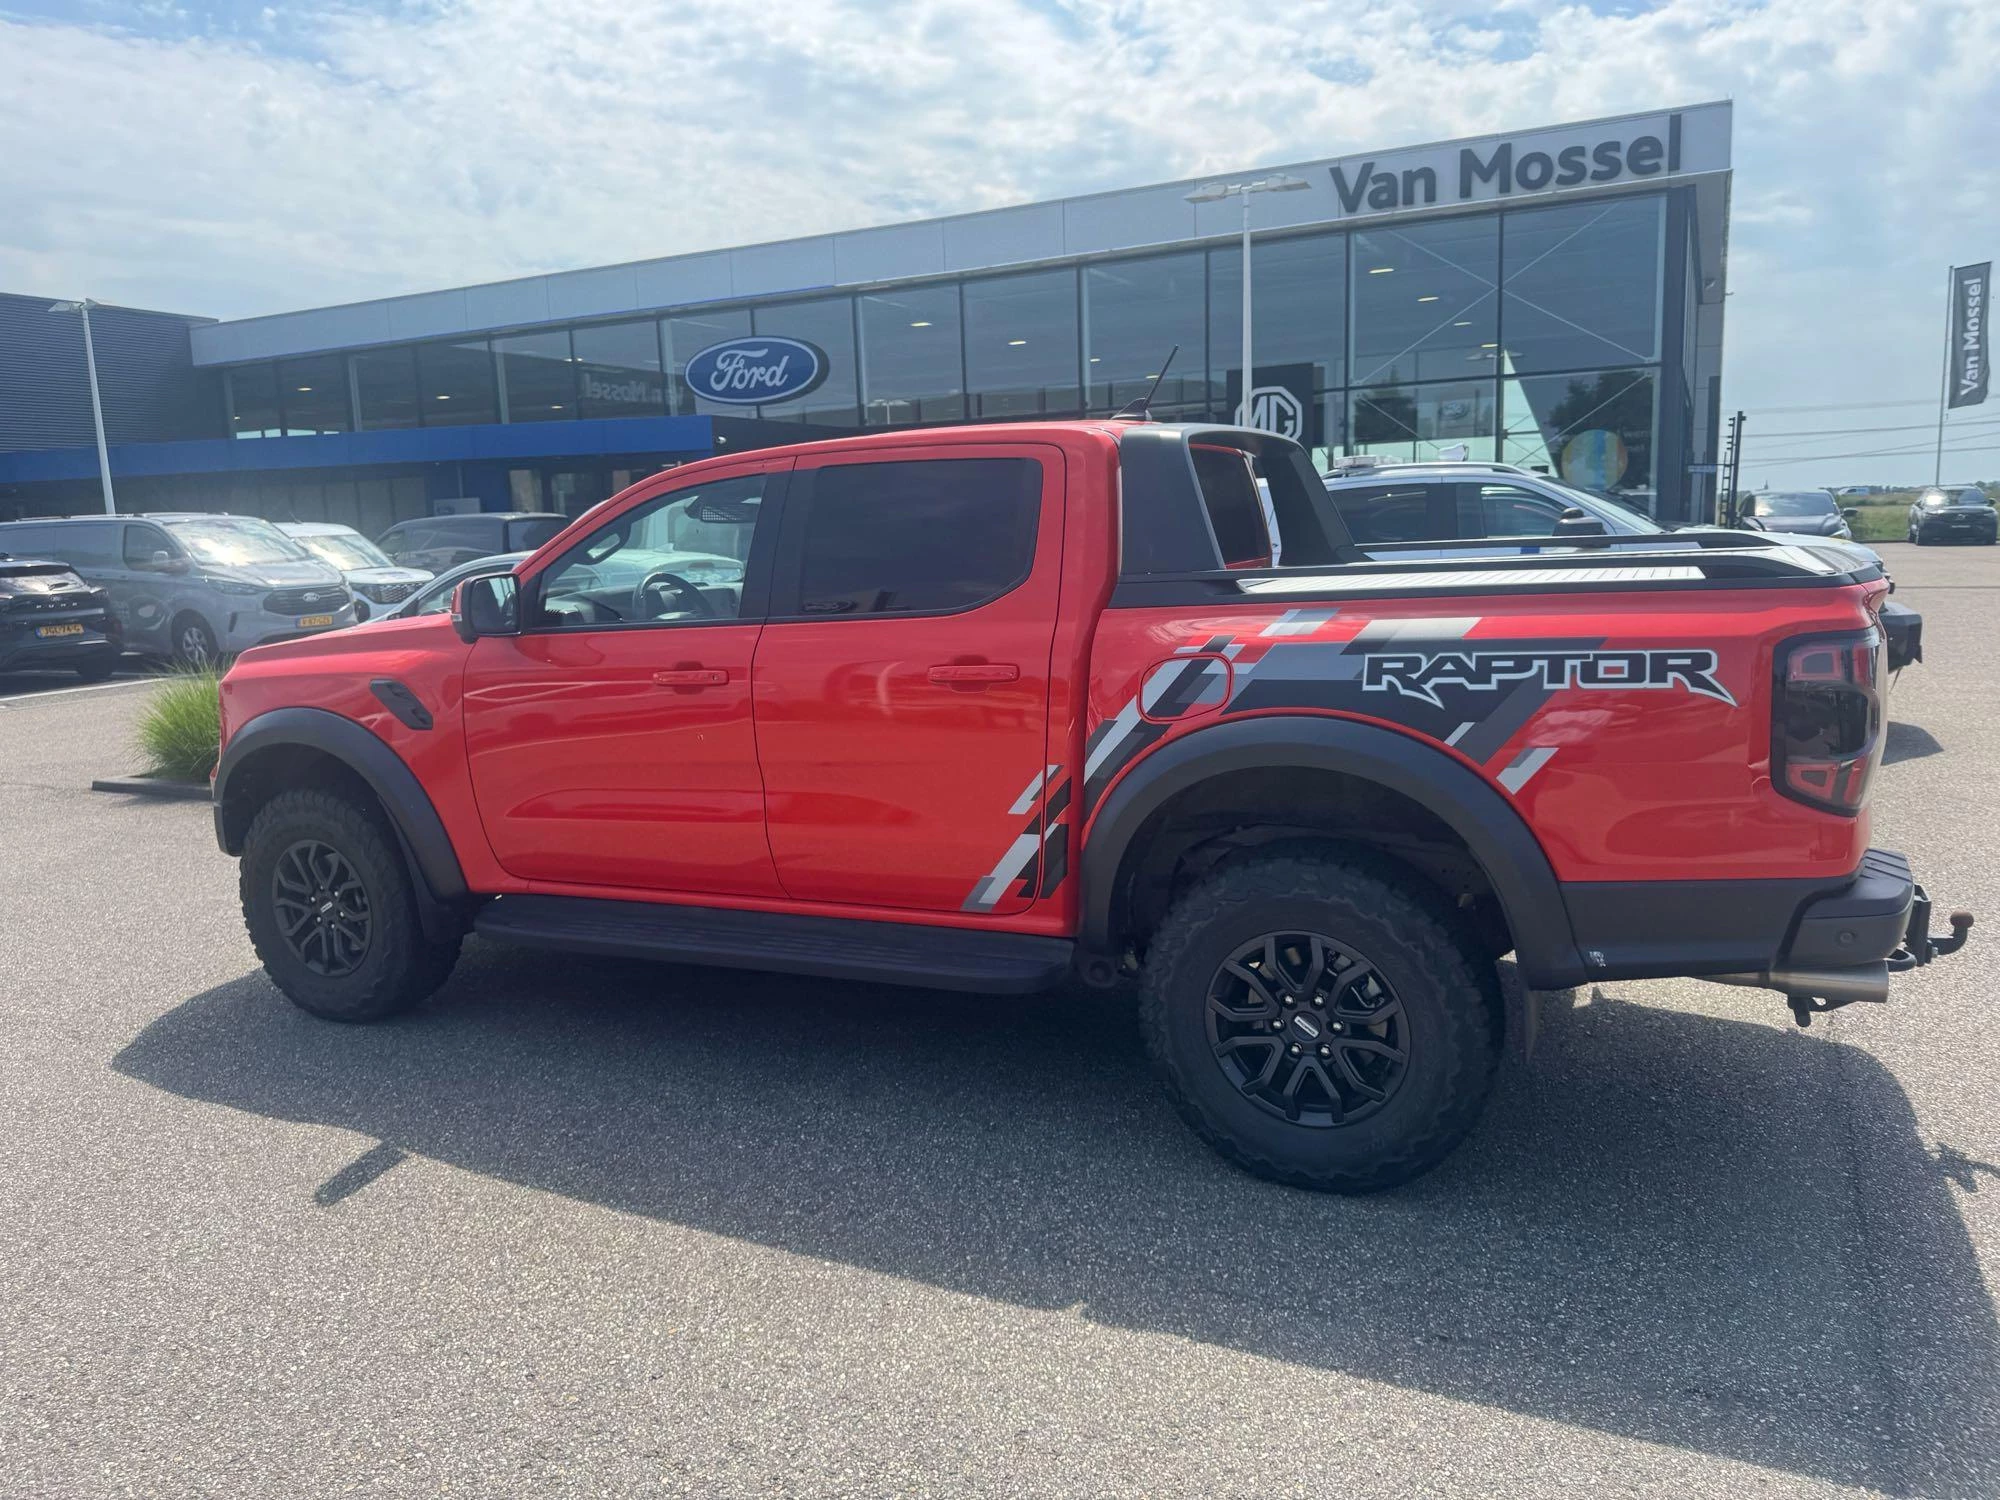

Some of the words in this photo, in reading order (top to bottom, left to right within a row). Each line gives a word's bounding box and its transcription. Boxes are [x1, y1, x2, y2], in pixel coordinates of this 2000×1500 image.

[1328, 161, 1436, 214] Van
[1459, 113, 1682, 199] Mossel
[1963, 277, 1982, 350] Mossel
[709, 348, 789, 392] Ford
[1960, 355, 1979, 395] Van
[1362, 649, 1738, 710] RAPTOR
